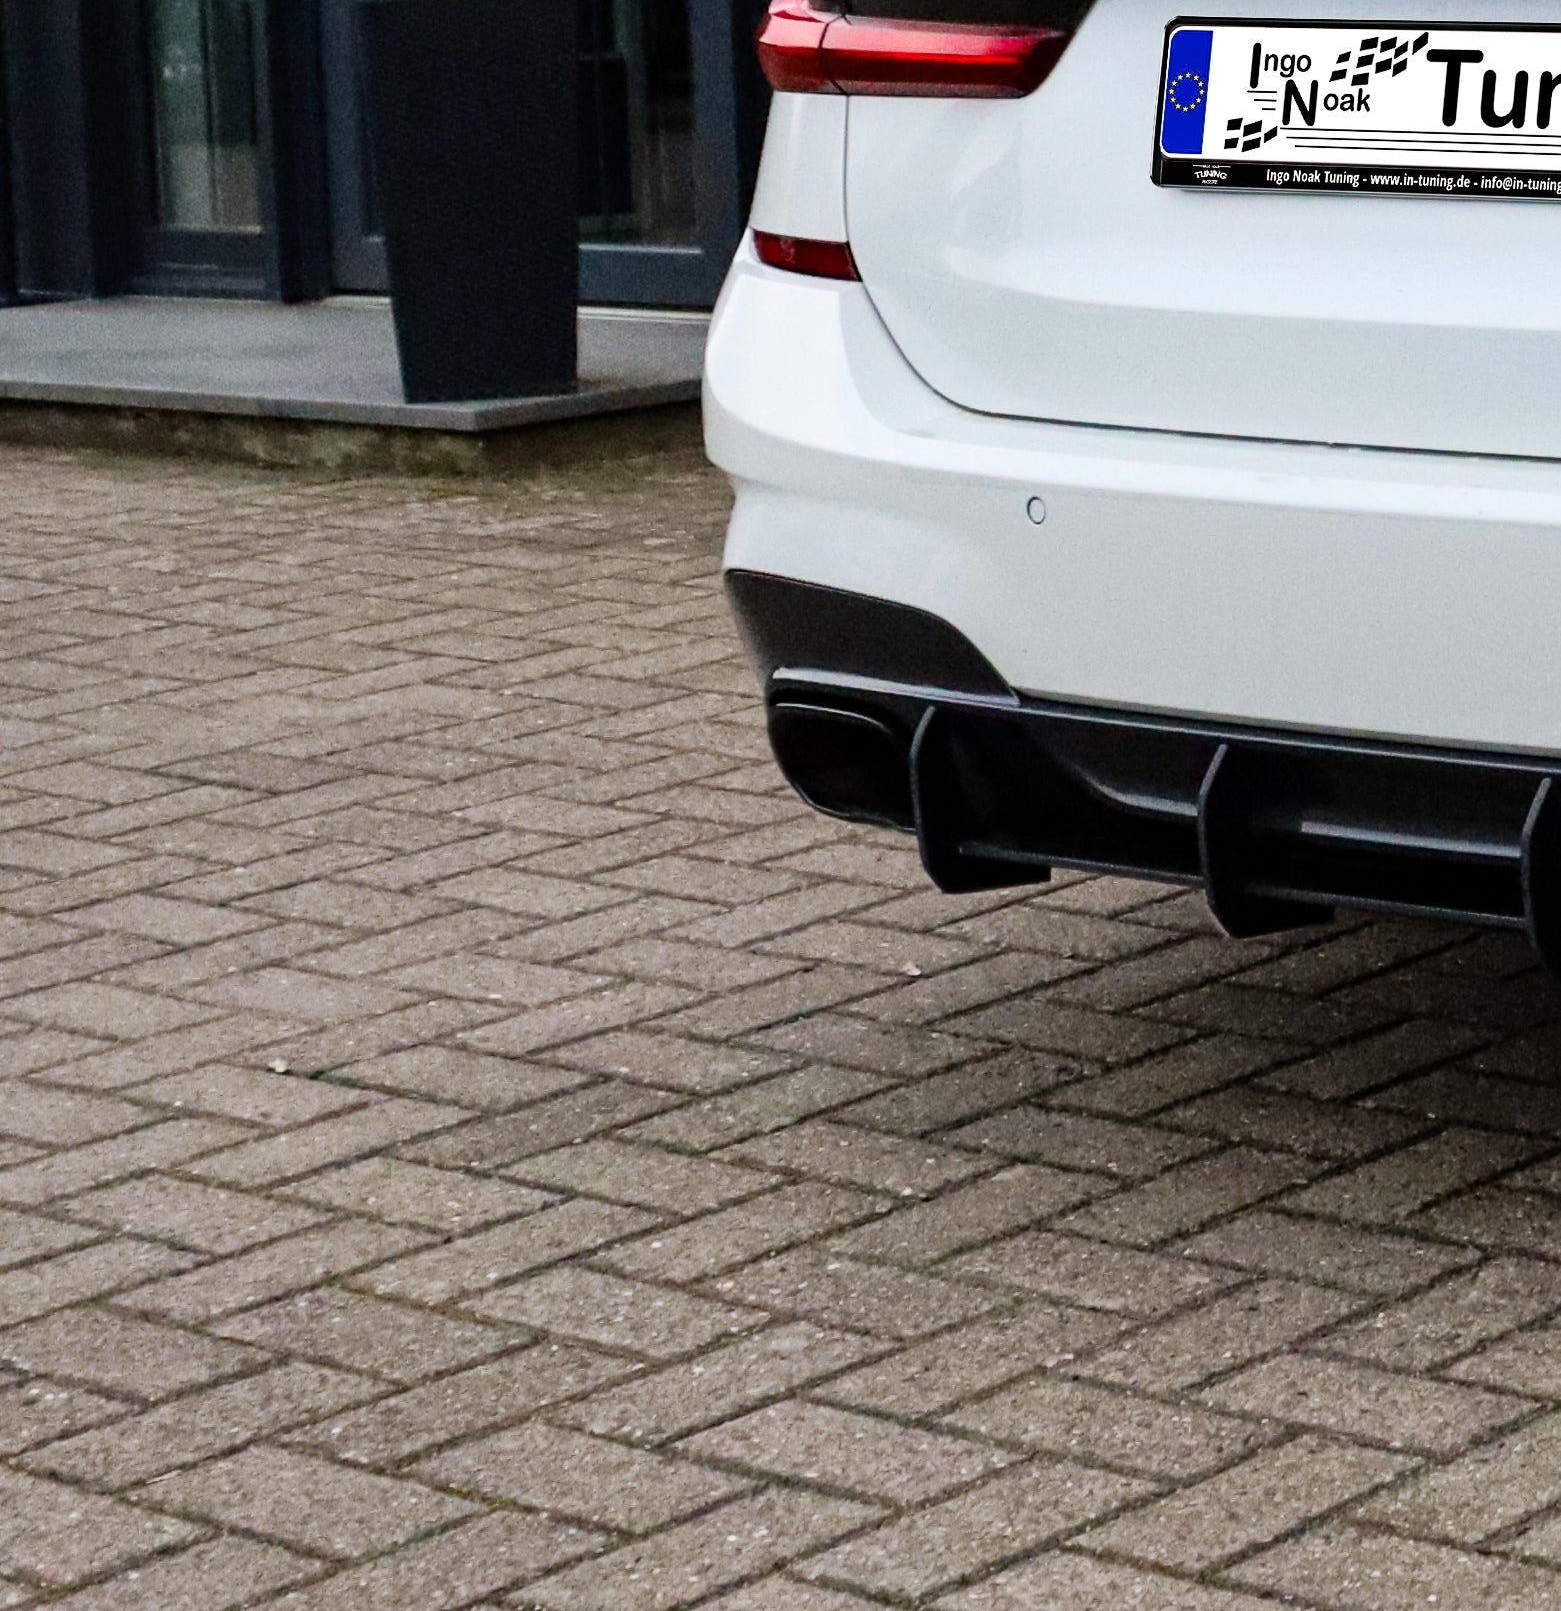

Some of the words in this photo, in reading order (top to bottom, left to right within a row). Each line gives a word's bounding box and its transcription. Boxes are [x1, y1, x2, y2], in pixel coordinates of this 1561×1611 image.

[1250, 42, 1312, 89] Ingo
[1282, 79, 1371, 127] Noak
[1266, 168, 1290, 185] Ingo
[1292, 169, 1321, 183] Noak
[1323, 170, 1360, 188] Tuning
[1370, 172, 1471, 191] www.in-tuning.de
